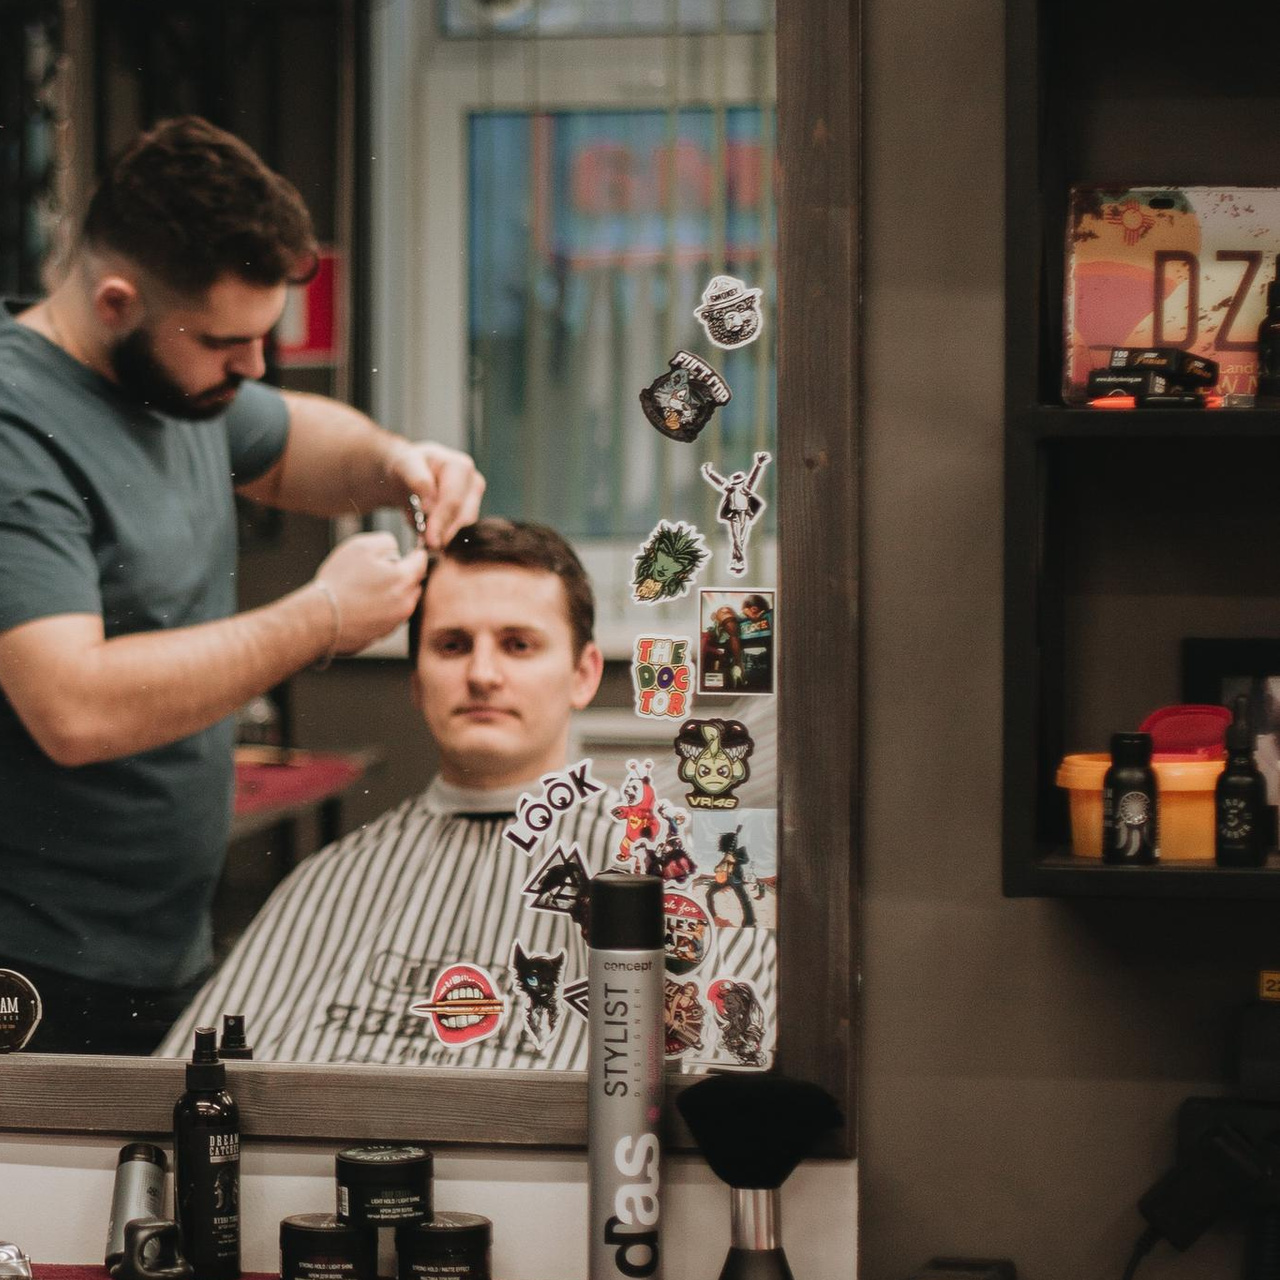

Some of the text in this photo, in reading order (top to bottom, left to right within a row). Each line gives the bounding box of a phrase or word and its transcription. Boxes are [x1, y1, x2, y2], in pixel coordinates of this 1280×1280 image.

[638, 638, 688, 665] THE
[506, 763, 601, 853] LOOK
[604, 961, 652, 971] concept
[604, 983, 628, 1097] STYLIST
[209, 1134, 239, 1147] DREAM
[209, 1145, 239, 1156] CATCHE
